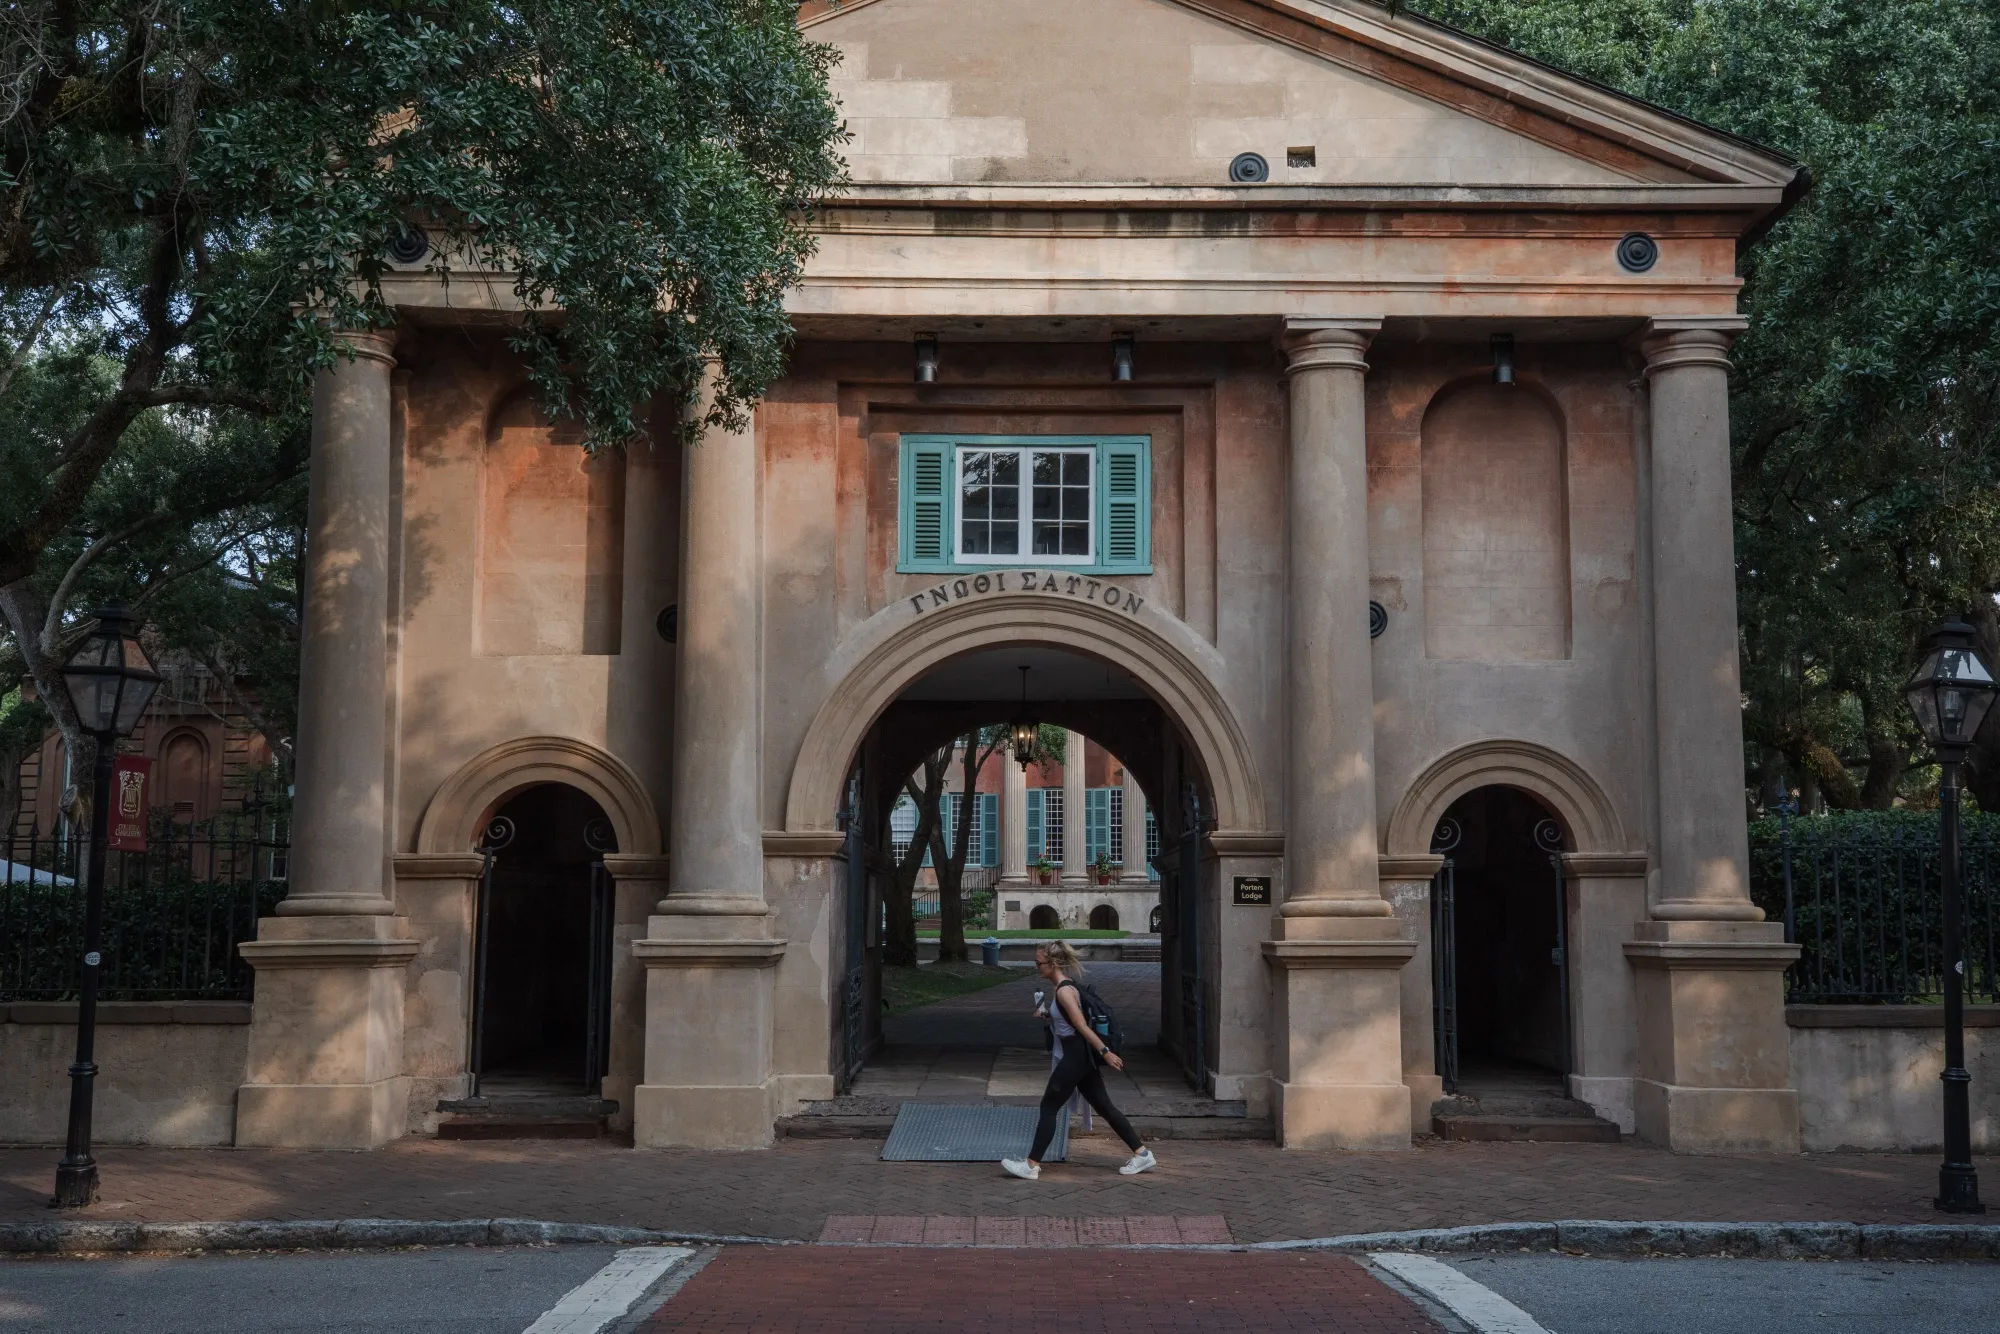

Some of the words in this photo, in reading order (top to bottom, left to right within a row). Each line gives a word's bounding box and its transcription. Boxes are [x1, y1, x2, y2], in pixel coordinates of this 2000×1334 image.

[910, 573, 1005, 614] ΓΝΩΘΙ
[1021, 572, 1144, 615] ΣΑΥΤΟΝ
[1241, 892, 1263, 901] Lodge
